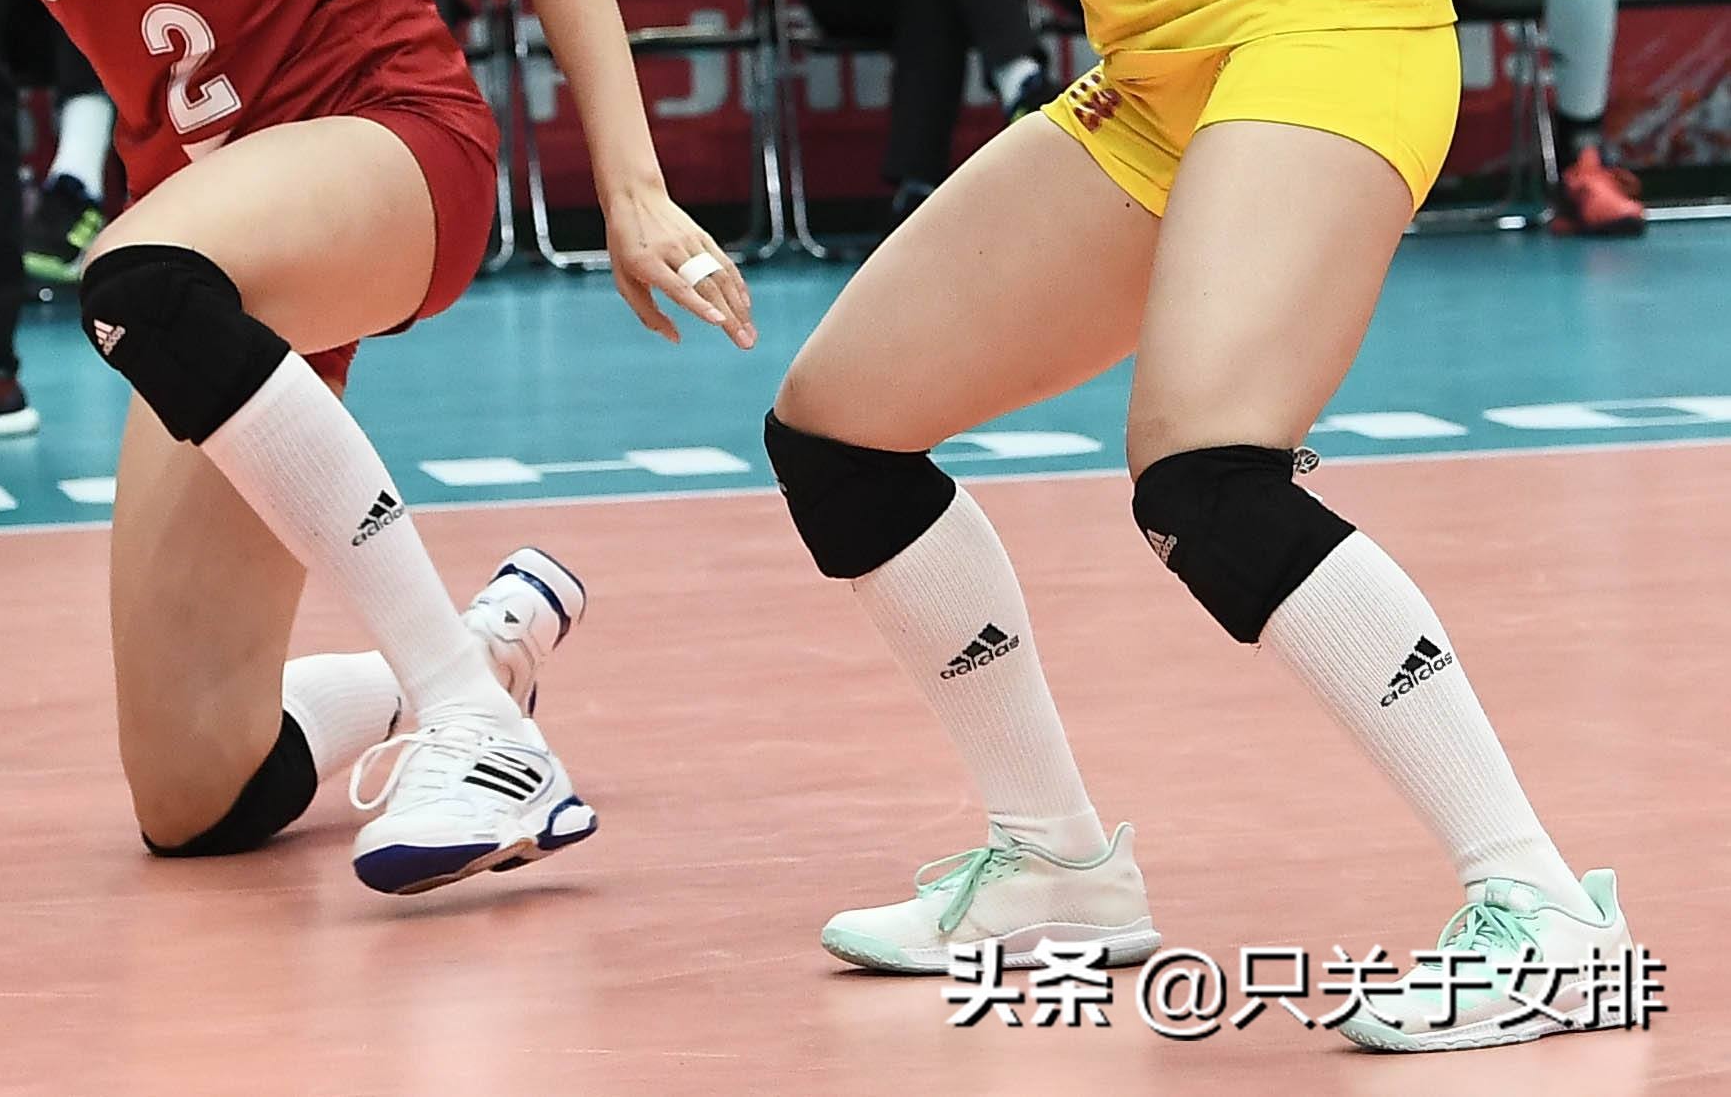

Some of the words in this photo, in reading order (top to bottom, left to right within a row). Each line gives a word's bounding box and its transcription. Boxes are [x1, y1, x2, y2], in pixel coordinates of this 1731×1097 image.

[141, 2, 242, 135] 2
[940, 635, 1020, 680] adidas
[1380, 652, 1452, 707] adidas
